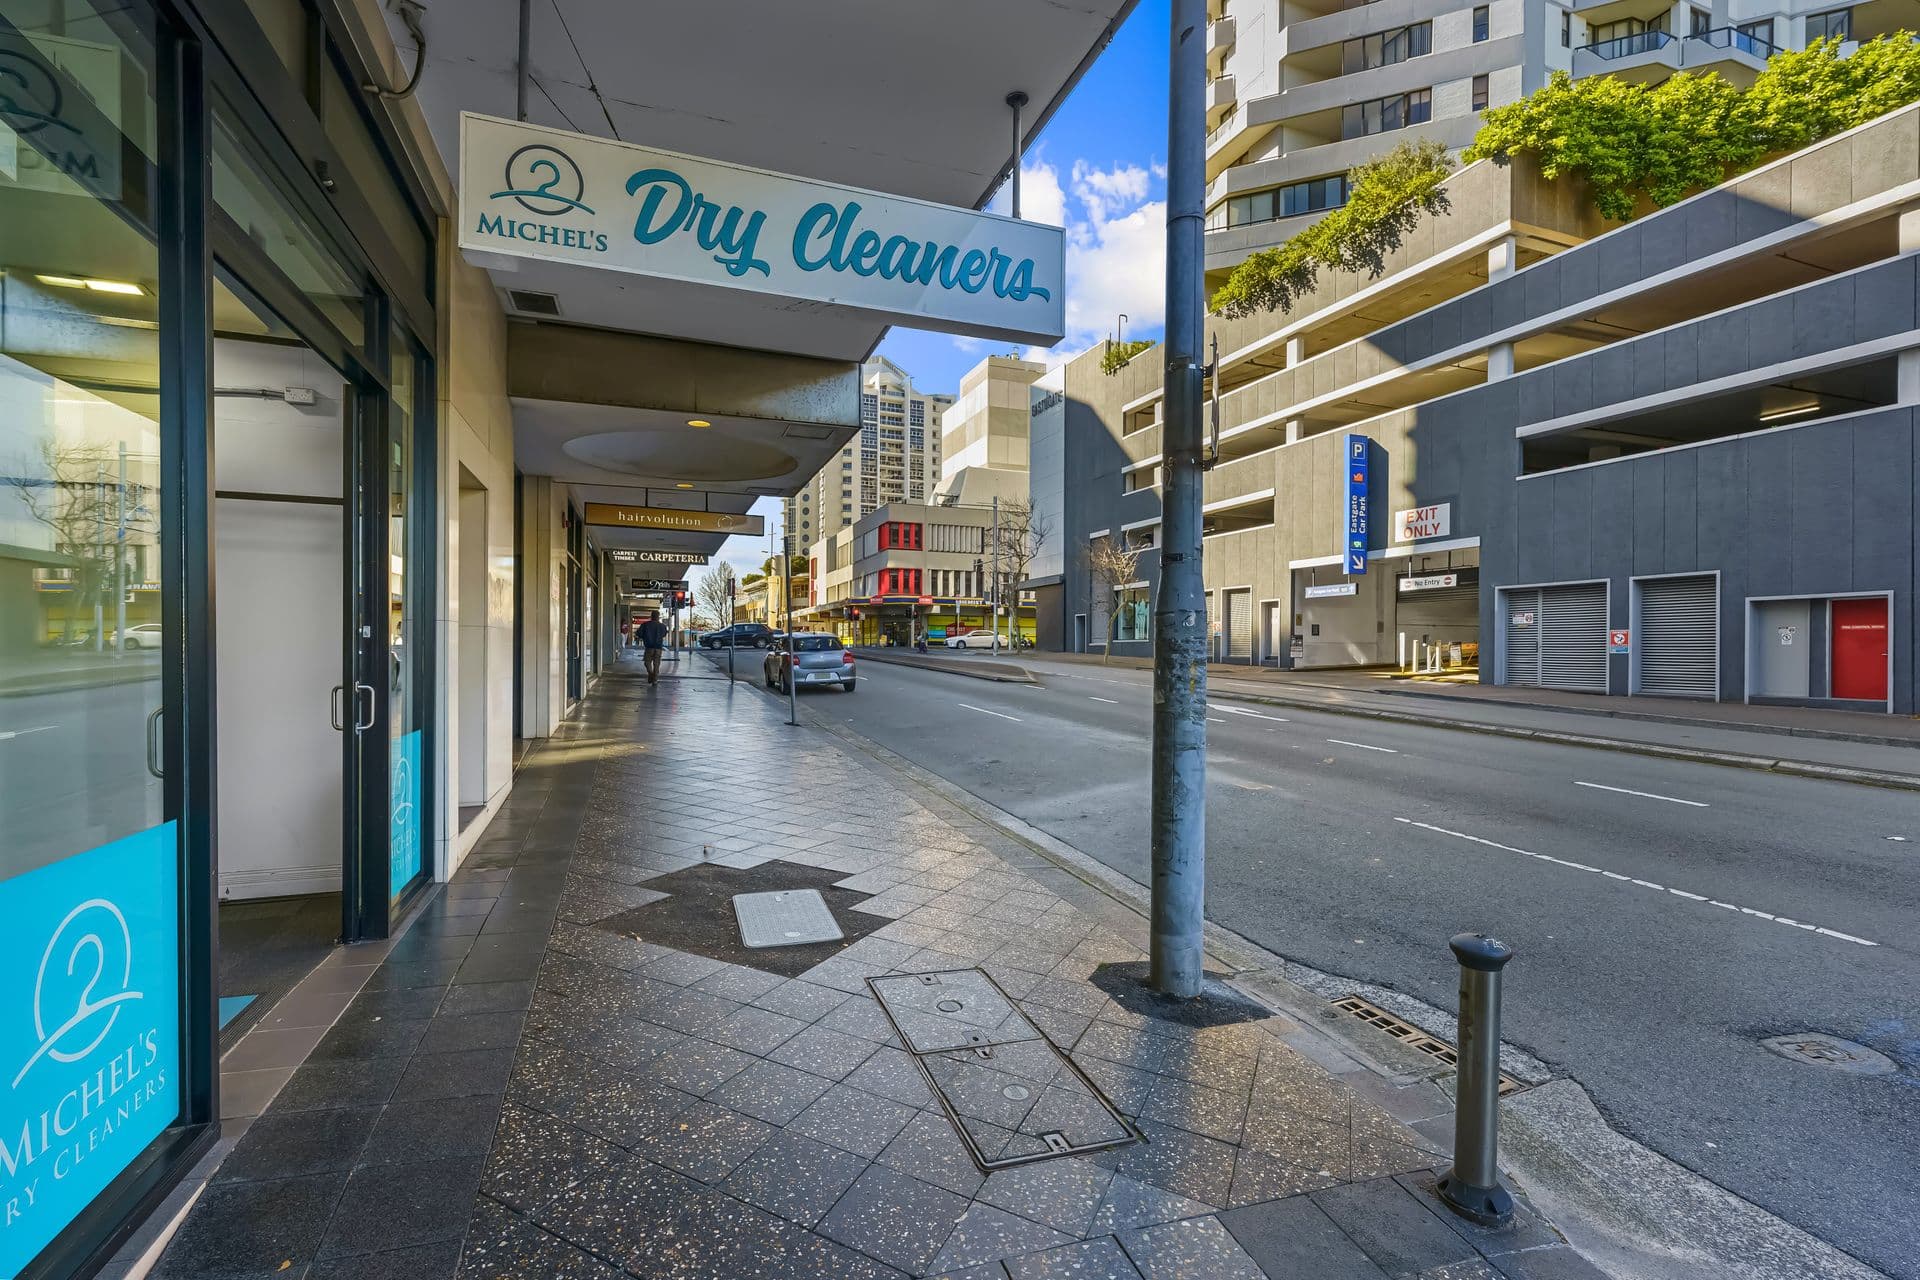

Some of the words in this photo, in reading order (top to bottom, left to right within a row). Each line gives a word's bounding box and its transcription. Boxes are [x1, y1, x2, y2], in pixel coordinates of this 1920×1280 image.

[476, 213, 608, 253] MICHEL'S
[625, 168, 771, 278] Dry
[792, 202, 1050, 303] Cleaners
[1353, 443, 1363, 457] P
[618, 511, 701, 527] hairvolution
[1351, 495, 1359, 533] Eastgate
[1407, 507, 1438, 523] EXIT
[1404, 522, 1441, 539] ONLY
[640, 552, 705, 563] CARPETERIA
[1424, 579, 1440, 587] Entry
[0, 1028, 158, 1188] MICHEL'S
[6, 1176, 40, 1229] RY
[53, 1068, 167, 1180] CLEANERS
